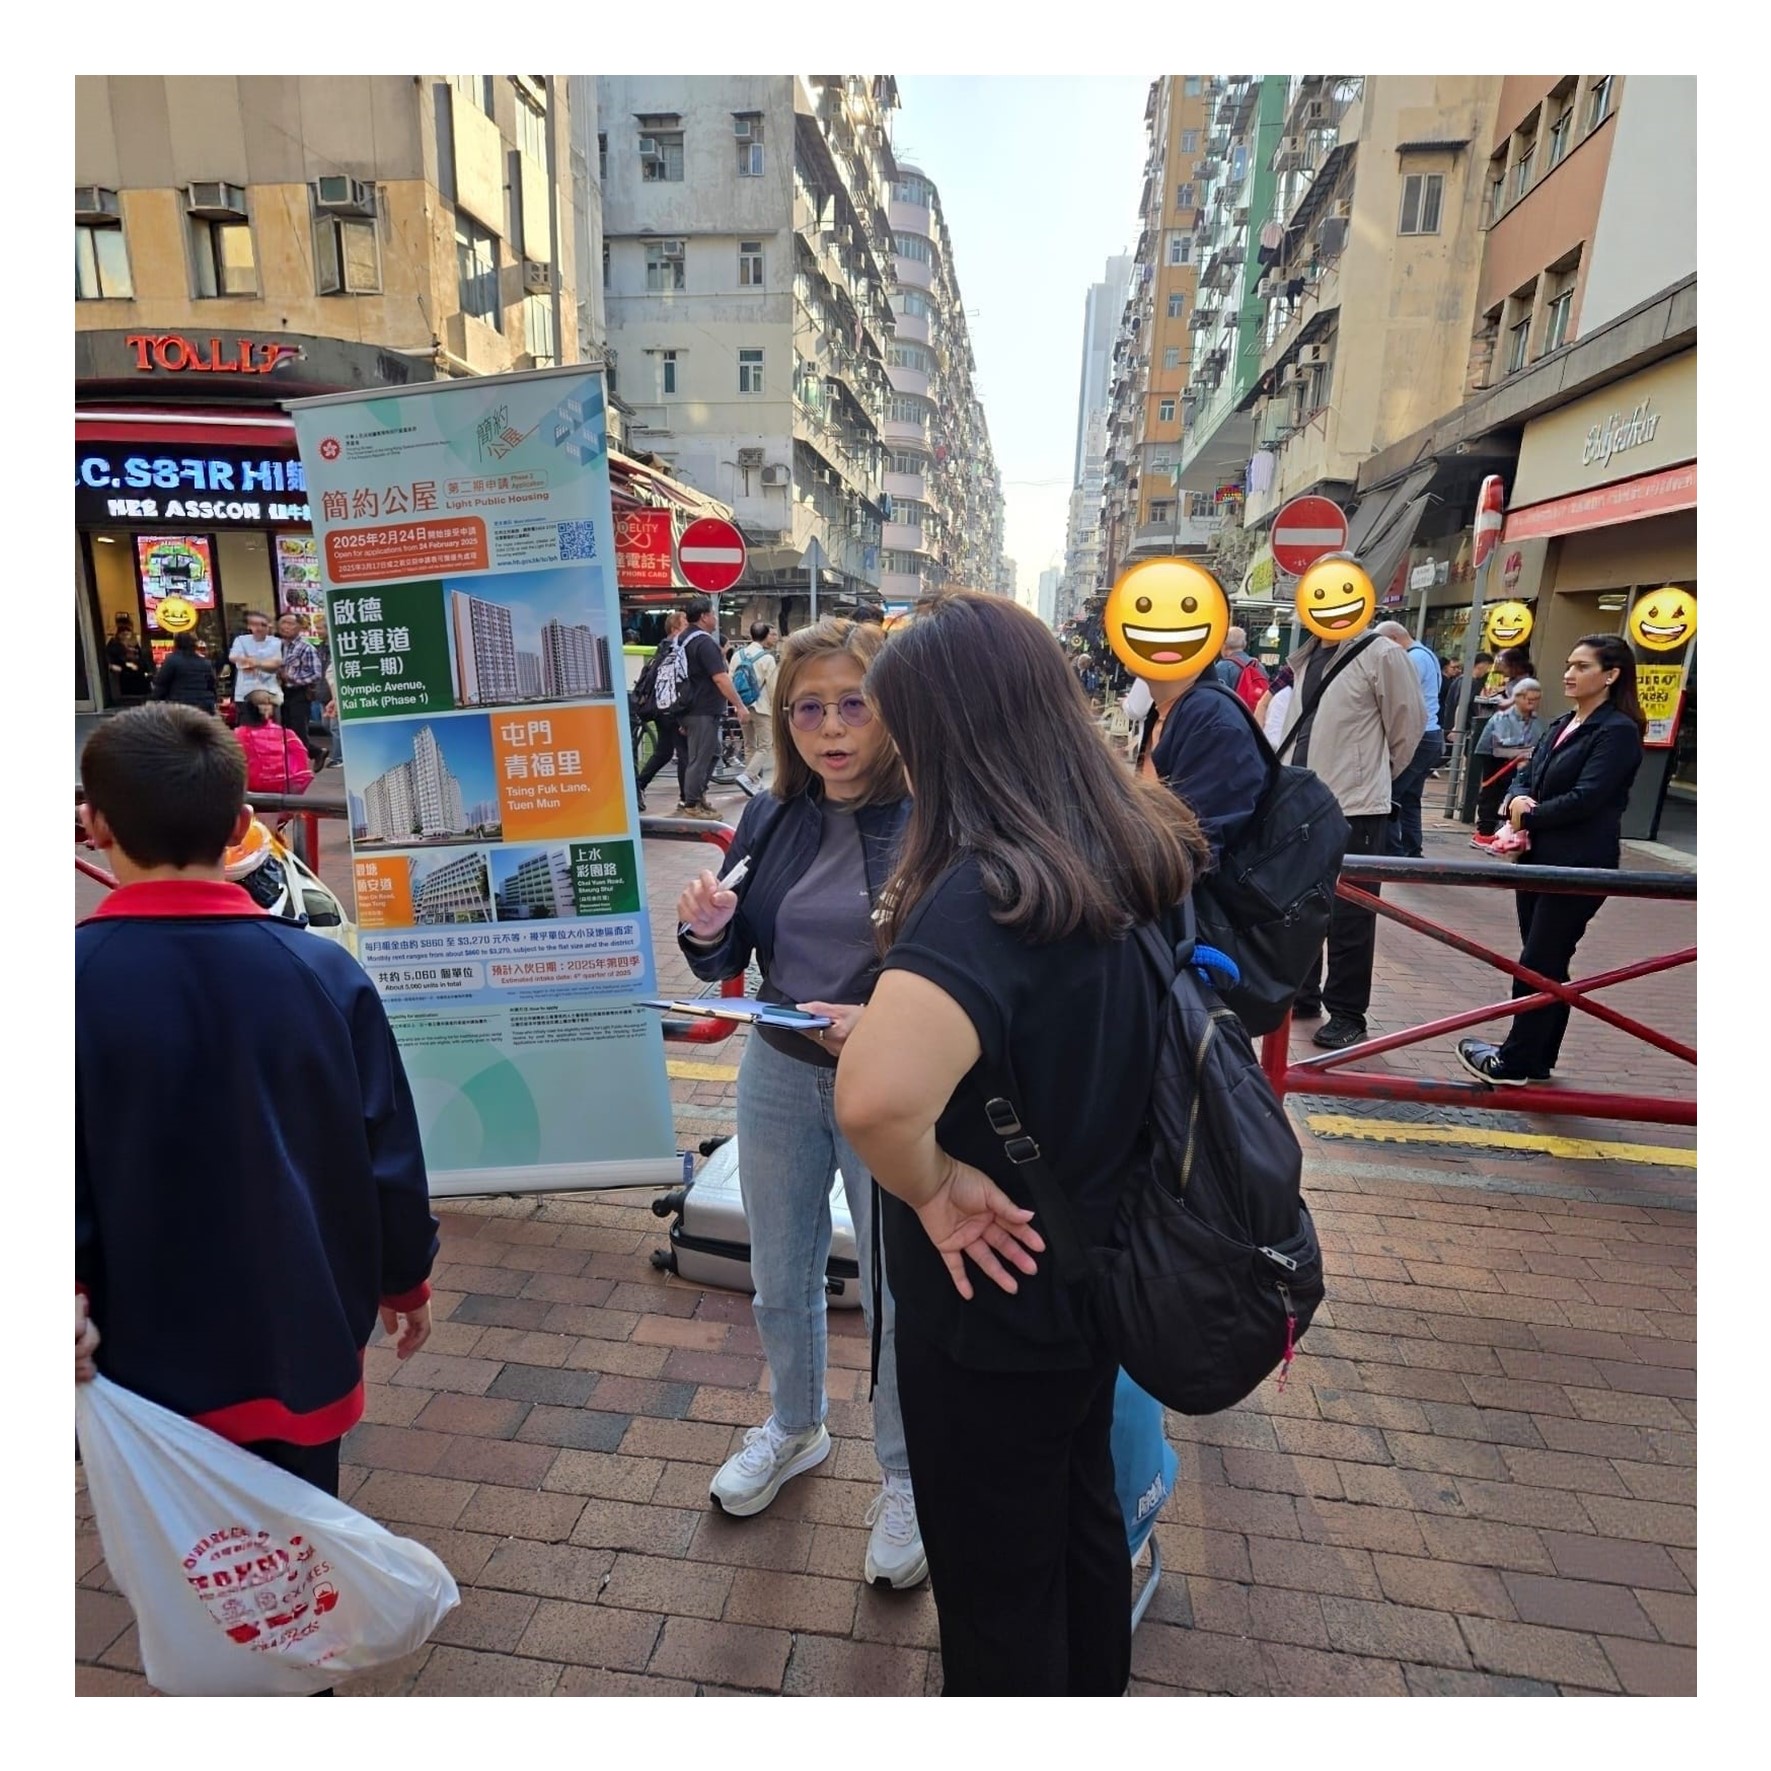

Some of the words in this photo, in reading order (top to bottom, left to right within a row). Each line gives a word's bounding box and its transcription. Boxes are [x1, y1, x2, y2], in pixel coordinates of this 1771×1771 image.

[447, 477, 509, 494] 第二期申請
[321, 480, 439, 522] 簡約公屋
[446, 499, 473, 510] Light
[475, 495, 507, 507] Public
[508, 490, 550, 504] Housing
[333, 551, 353, 560] Open
[353, 549, 364, 558] for
[363, 545, 403, 557] applications
[403, 544, 419, 552] from
[419, 542, 428, 550] 24
[428, 539, 460, 549] February
[461, 538, 479, 546] 2025
[332, 596, 383, 625] 啟德
[336, 626, 411, 657] 世運道
[339, 656, 404, 679] (第一期)
[340, 683, 382, 697] Olympic
[384, 680, 426, 692] Avenue,
[342, 699, 358, 710] Kai
[359, 697, 379, 708] Tak
[381, 694, 417, 708] (Phase
[418, 692, 429, 704] 1)
[500, 719, 553, 747] 屯門
[504, 750, 583, 779] 青福里
[506, 785, 535, 797] Tsing
[537, 784, 558, 795] Fuk
[560, 782, 591, 793] Lane,
[507, 801, 534, 811] Tuen
[537, 799, 560, 809] Mun
[575, 847, 602, 862] 上水
[576, 862, 617, 878] 彩園路
[367, 954, 391, 962] Monthly
[406, 952, 428, 961] ranges
[429, 951, 444, 959] from
[445, 949, 464, 957] about
[513, 945, 537, 954] subject
[546, 943, 557, 951] the
[610, 938, 634, 947] district
[446, 937, 456, 947] 至
[457, 935, 490, 946] $3,270
[379, 972, 400, 983] 共約
[403, 970, 437, 981] 5,060
[441, 967, 474, 979] 個單位
[501, 976, 533, 984] Estimated
[536, 973, 555, 982] intake
[556, 973, 572, 981] date:
[583, 971, 607, 980] quarter
[615, 969, 632, 977] 2025
